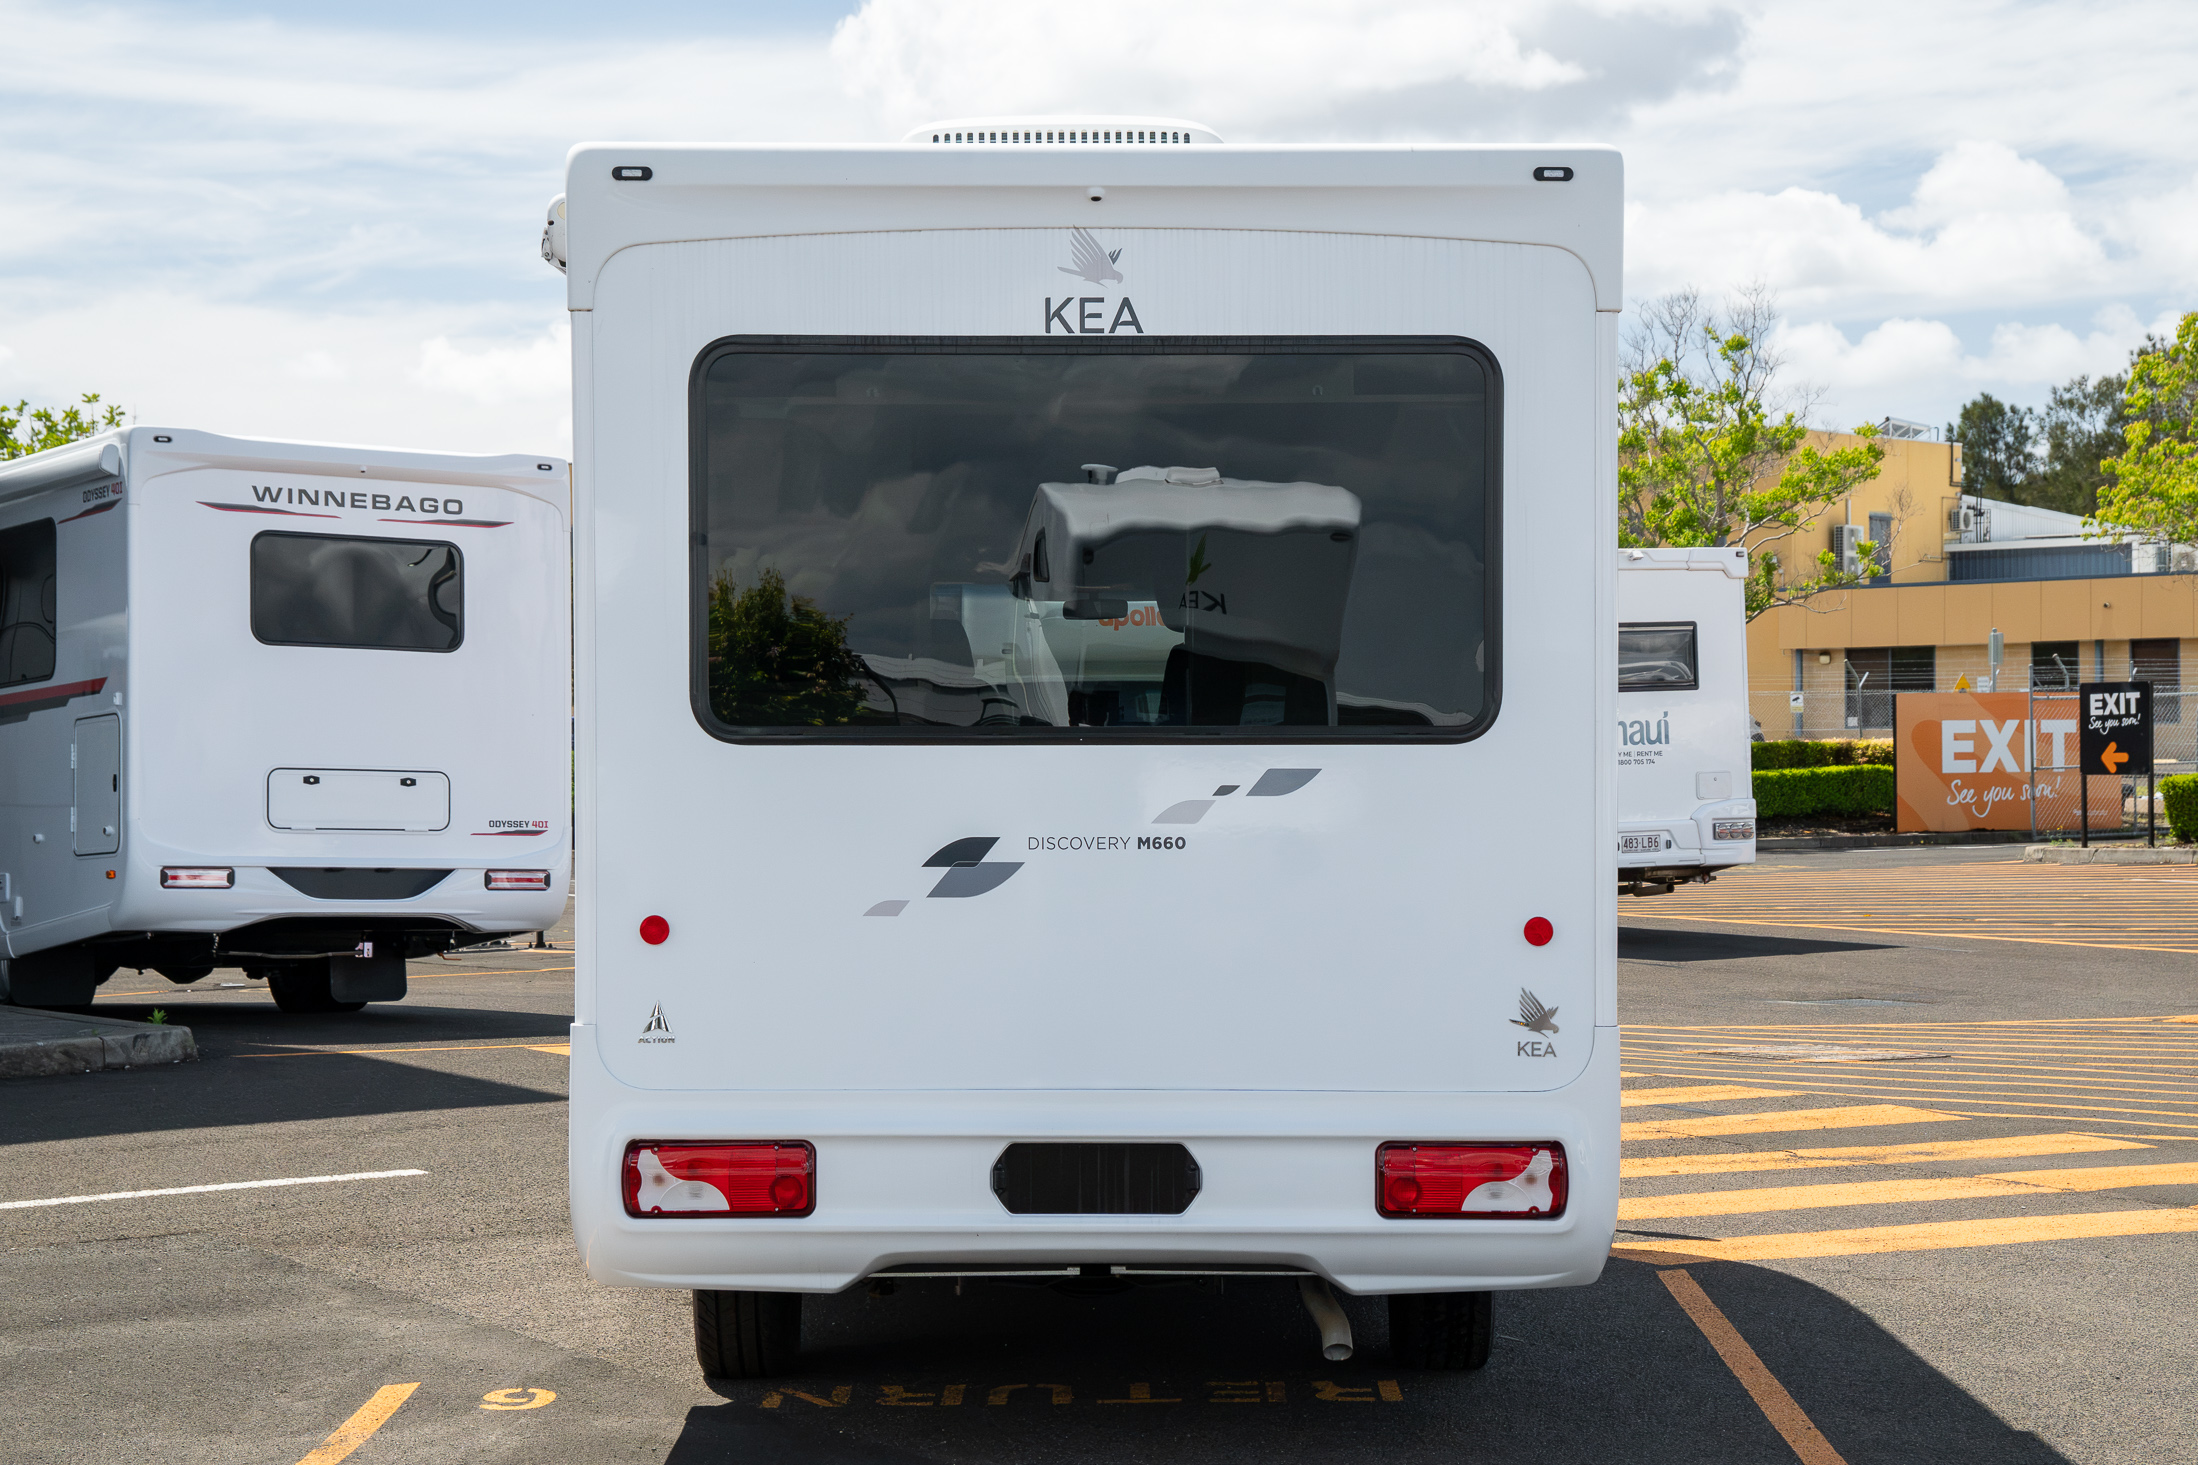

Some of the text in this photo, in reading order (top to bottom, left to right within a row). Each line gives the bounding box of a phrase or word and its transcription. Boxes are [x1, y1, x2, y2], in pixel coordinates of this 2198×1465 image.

[1044, 296, 1144, 334] KEA
[251, 485, 463, 515] WINNEBAGO
[2089, 691, 2141, 716] EXIT
[2088, 716, 2103, 730] See
[2100, 719, 2120, 735] you
[1636, 750, 1653, 758] RENT
[1941, 719, 2077, 773] EXIT
[1947, 779, 1978, 805] See
[1972, 785, 2015, 818] you
[488, 820, 530, 828] ODYSSEY
[1028, 836, 1187, 850] DISCOVERY M660
[638, 1035, 676, 1044] ACTION
[1517, 1041, 1557, 1058] KEA
